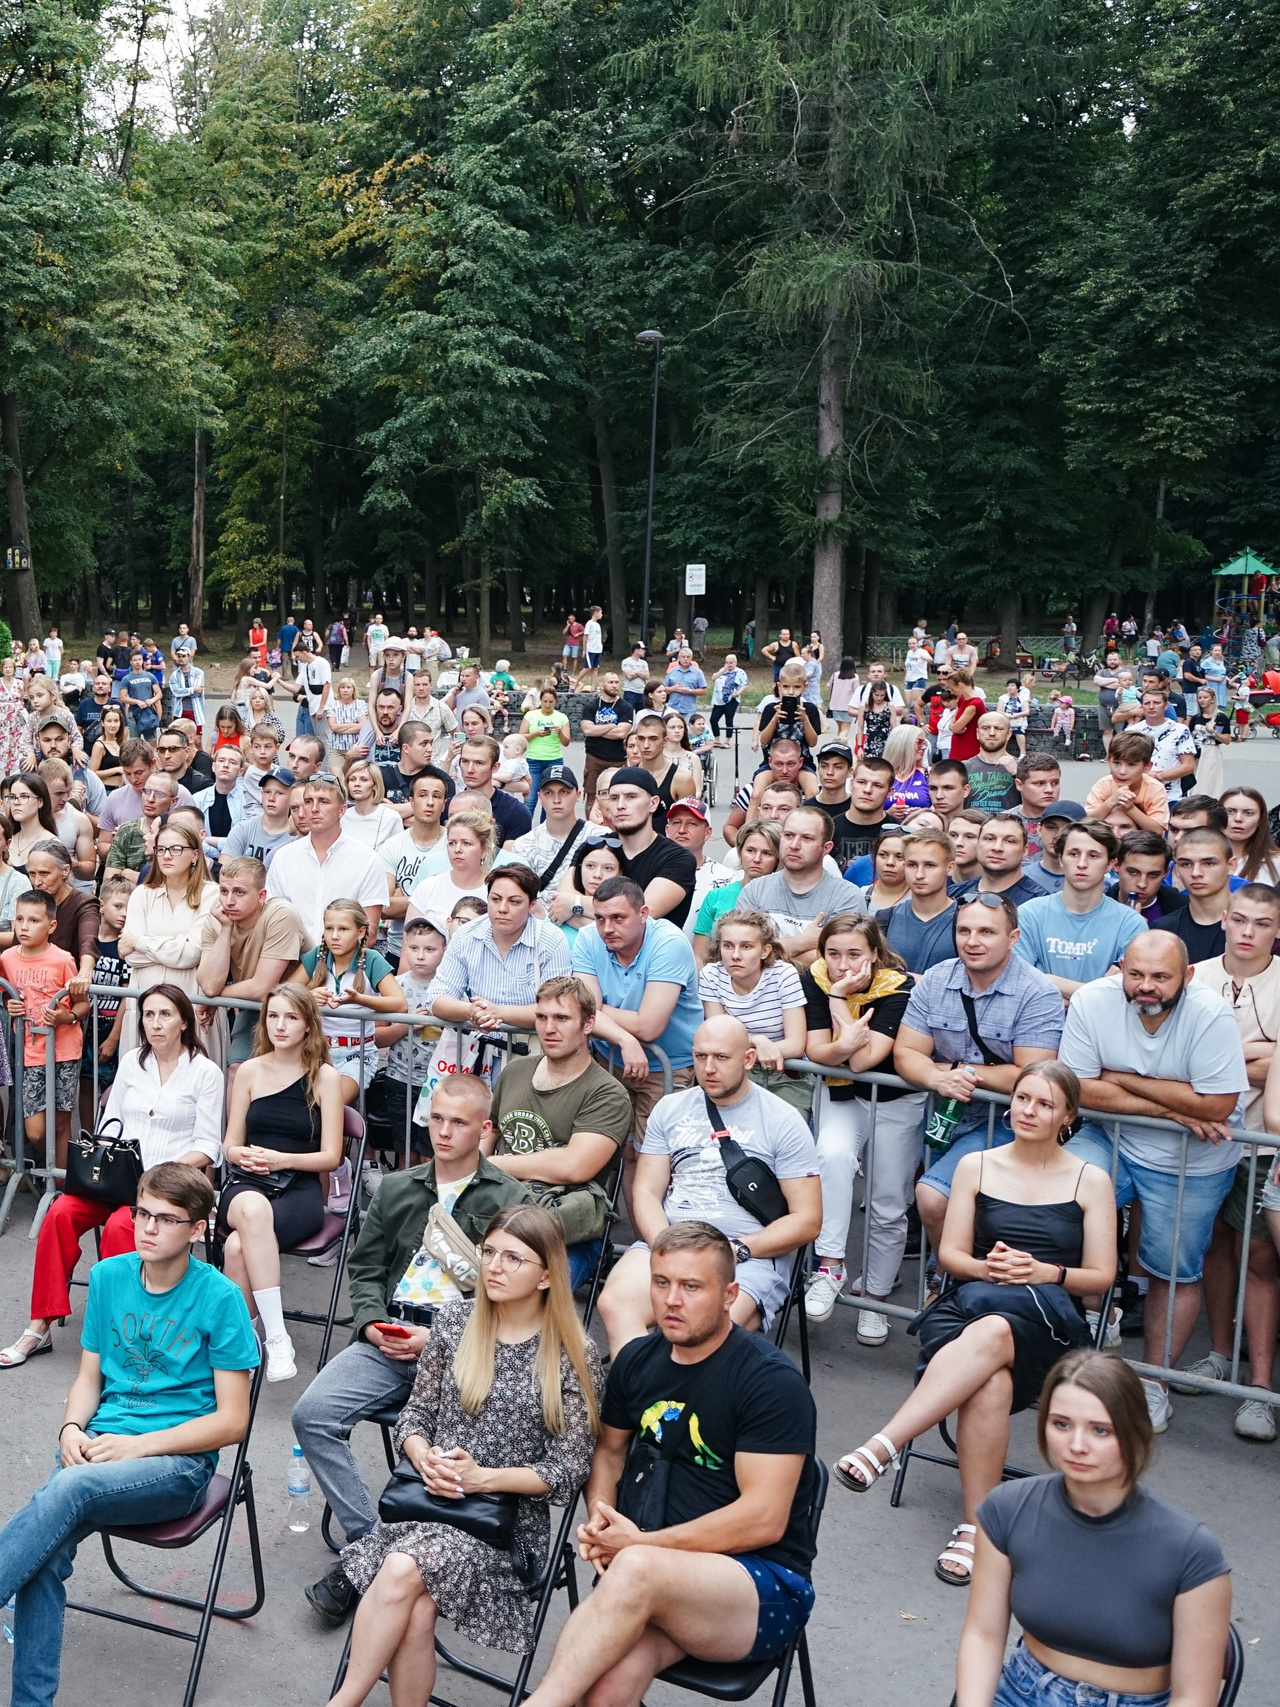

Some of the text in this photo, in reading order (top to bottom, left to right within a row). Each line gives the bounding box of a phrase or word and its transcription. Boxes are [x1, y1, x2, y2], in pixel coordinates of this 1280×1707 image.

[1046, 938, 1099, 956] TOMMY
[512, 1121, 536, 1154] B
[110, 1312, 199, 1359] SOUTH
